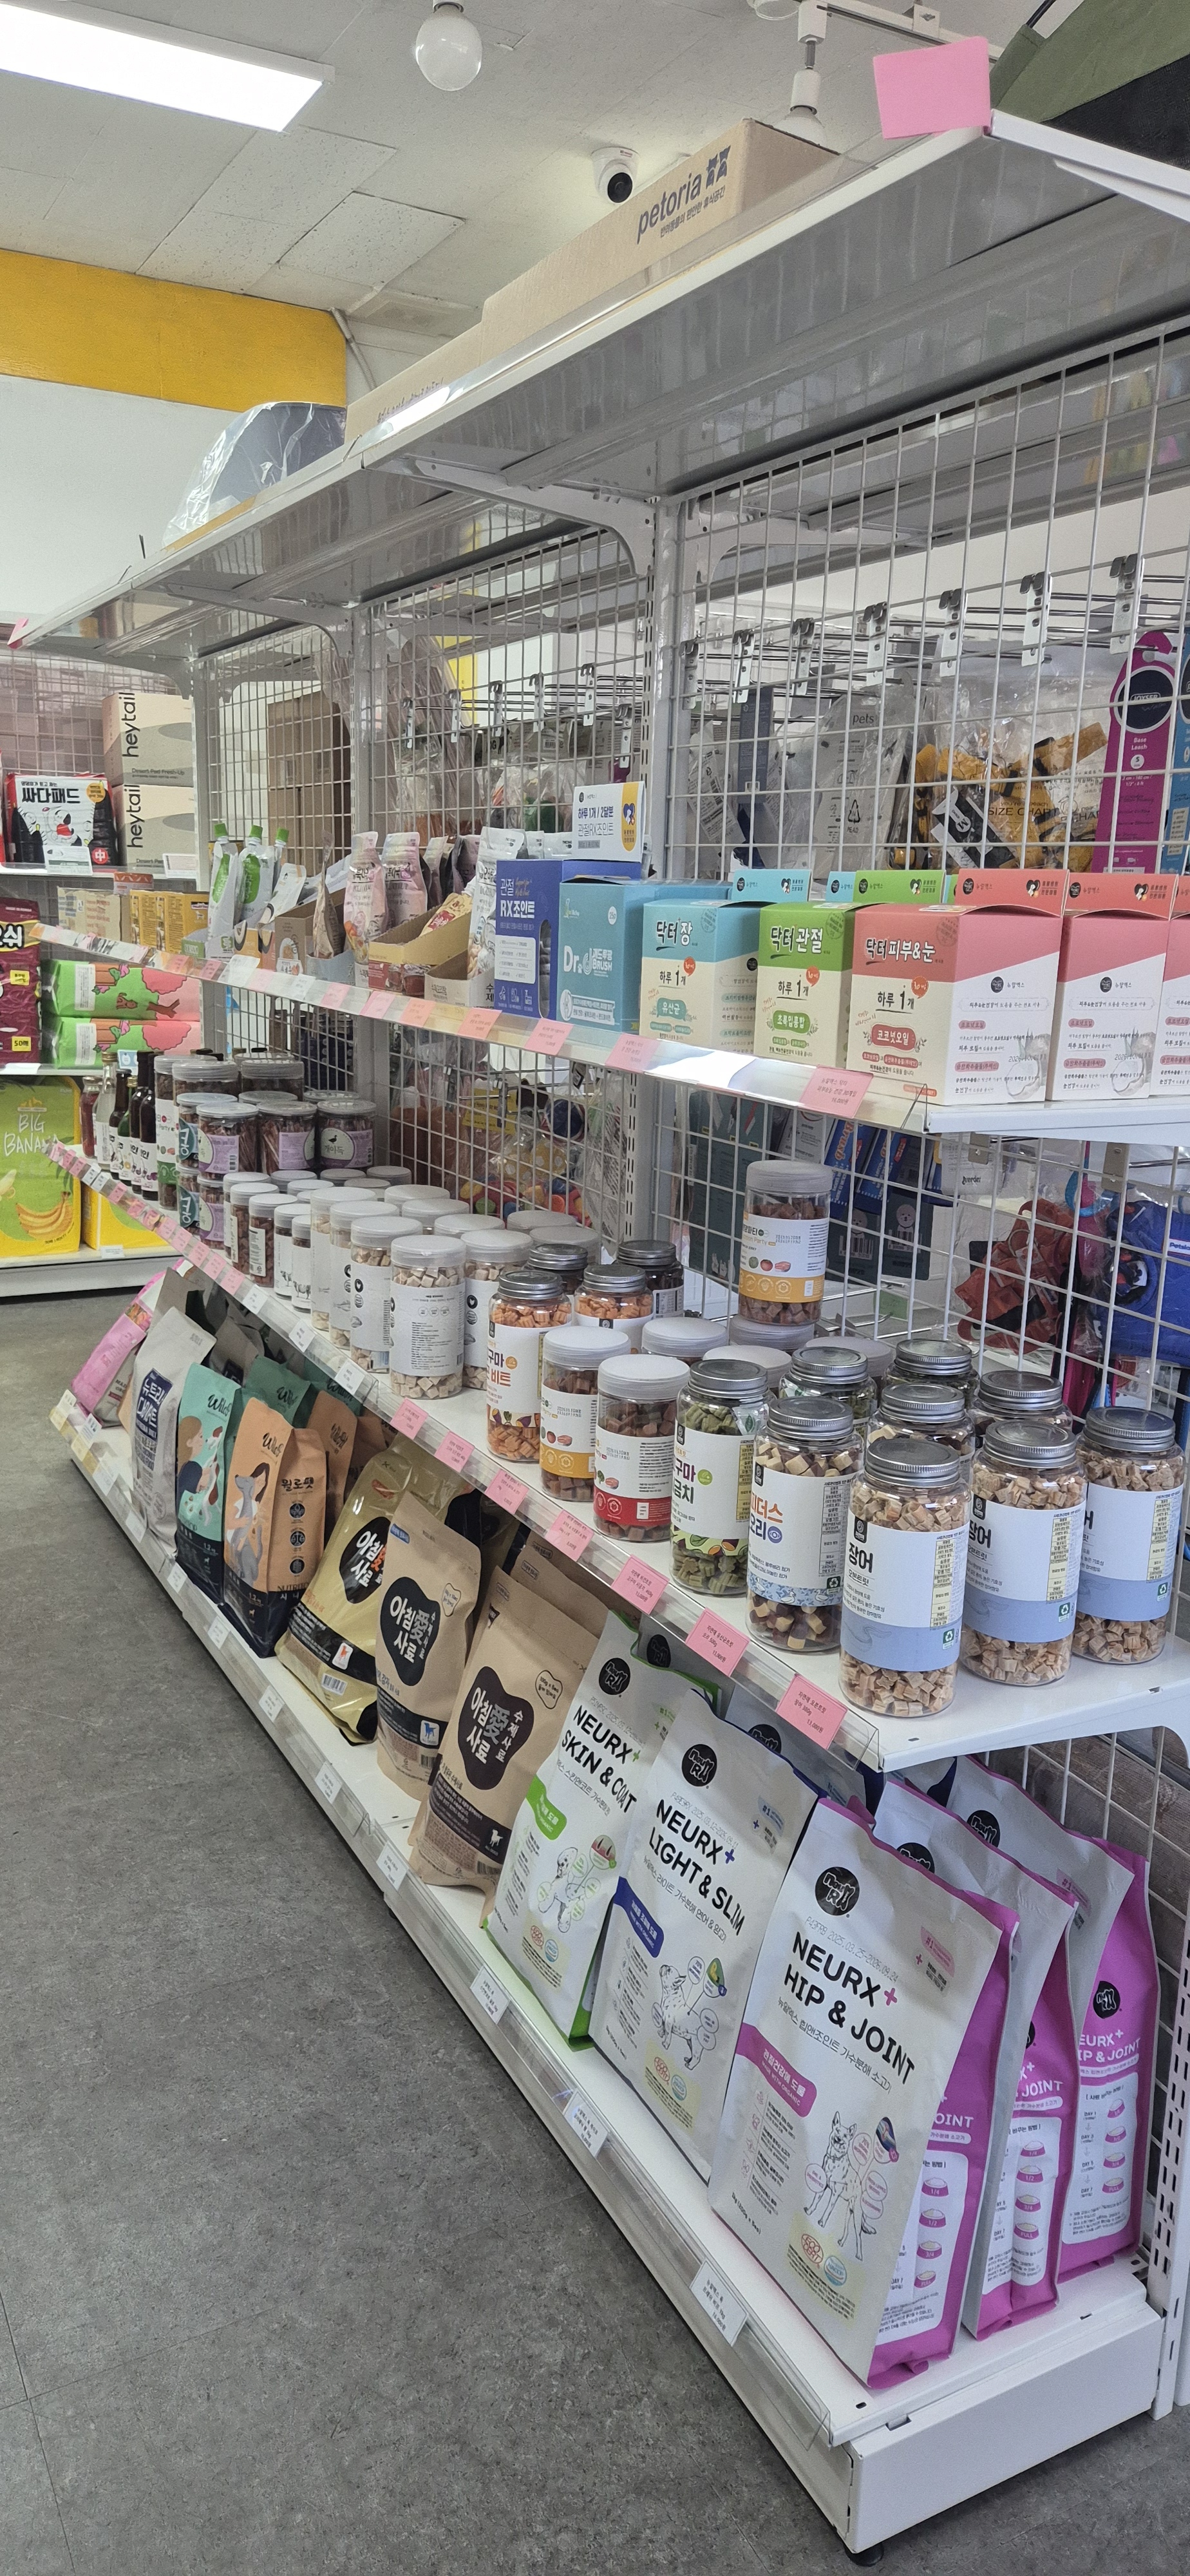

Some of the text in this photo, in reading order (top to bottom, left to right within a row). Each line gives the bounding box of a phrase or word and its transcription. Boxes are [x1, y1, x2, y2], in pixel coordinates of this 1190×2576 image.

[638, 173, 701, 245] petoria
[686, 202, 702, 221] 편안한
[703, 185, 726, 209] 휴식공간
[118, 692, 140, 757] heytail
[853, 714, 874, 724] pets
[22, 787, 81, 804] 싸다패드
[124, 785, 145, 848] heytail
[578, 805, 614, 820] 하루 1개 2달분
[578, 822, 614, 837] 관절RX조인트
[95, 849, 105, 862] 中
[500, 878, 515, 896] 관절
[500, 900, 535, 919] RX조인트
[656, 920, 693, 947] 닥터 장
[771, 925, 824, 954] 닥터 관절
[865, 938, 936, 963] 닥터 피부&눈
[592, 961, 612, 972] BRUSH
[660, 971, 672, 983] 하루
[778, 980, 792, 995] 하루
[662, 1002, 681, 1014] 유산균
[877, 991, 895, 1007] 하루
[777, 1014, 805, 1030] 초록입홍합
[876, 1030, 909, 1046] 코코넛오일
[19, 1113, 46, 1133] BIG
[753, 1236, 768, 1246] Party
[491, 1370, 511, 1387] 비트
[281, 1477, 314, 1493] 윌로펫
[750, 1517, 766, 1540] 오리
[969, 1519, 991, 1548] 장어
[849, 1541, 873, 1573] 장어
[350, 1561, 370, 1587] 사료
[873, 1604, 885, 1613] 기호성
[709, 1637, 717, 1647] 500g
[717, 1631, 734, 1647] 유산균트릿
[393, 1636, 417, 1665] 사료
[712, 1650, 726, 1663] 13,000원
[540, 1676, 549, 1687] 100g
[470, 1687, 511, 1745] 아침愛
[795, 1699, 812, 1716] 장어 380g
[810, 1700, 826, 1714] 오븐트릿
[807, 1719, 824, 1733] 13,000원
[466, 1725, 488, 1766] 사료
[495, 1710, 524, 1764] 수제사료
[561, 1729, 638, 1814] SKIN & COAT
[565, 1766, 592, 1796] 스킨앤코트
[649, 1826, 745, 1937] LIGHT & SLIM
[656, 1873, 714, 1930] 라이트 가수분해 연어 &
[827, 1929, 899, 1984] 2025.03.25-2026.09.24
[783, 1964, 918, 2086] HIP & JOINT
[777, 1996, 893, 2094] 뉴알엑스 힙앤조인트 가수분해 소고기
[1097, 2037, 1141, 2063] & JOINT
[763, 2048, 791, 2084] 관절건강에
[790, 2079, 806, 2098] 도움
[771, 2072, 782, 2087] WITH
[781, 2084, 801, 2107] ORGANIC
[1022, 2080, 1064, 2099] JOINT
[1026, 2124, 1039, 2132] 방법
[950, 2133, 965, 2142] 소고기
[932, 2160, 944, 2169] 방법
[930, 2188, 940, 2196] 1/4
[1081, 2186, 1090, 2195] DAY
[928, 2218, 939, 2227] 1/2
[803, 2241, 820, 2264] CERT
[804, 2236, 820, 2254] ECO
[925, 2250, 936, 2259] 3/4
[706, 2279, 719, 2298] 뉴알엑스
[920, 2279, 932, 2287] FULL
[712, 2312, 726, 2331] 16,000원
